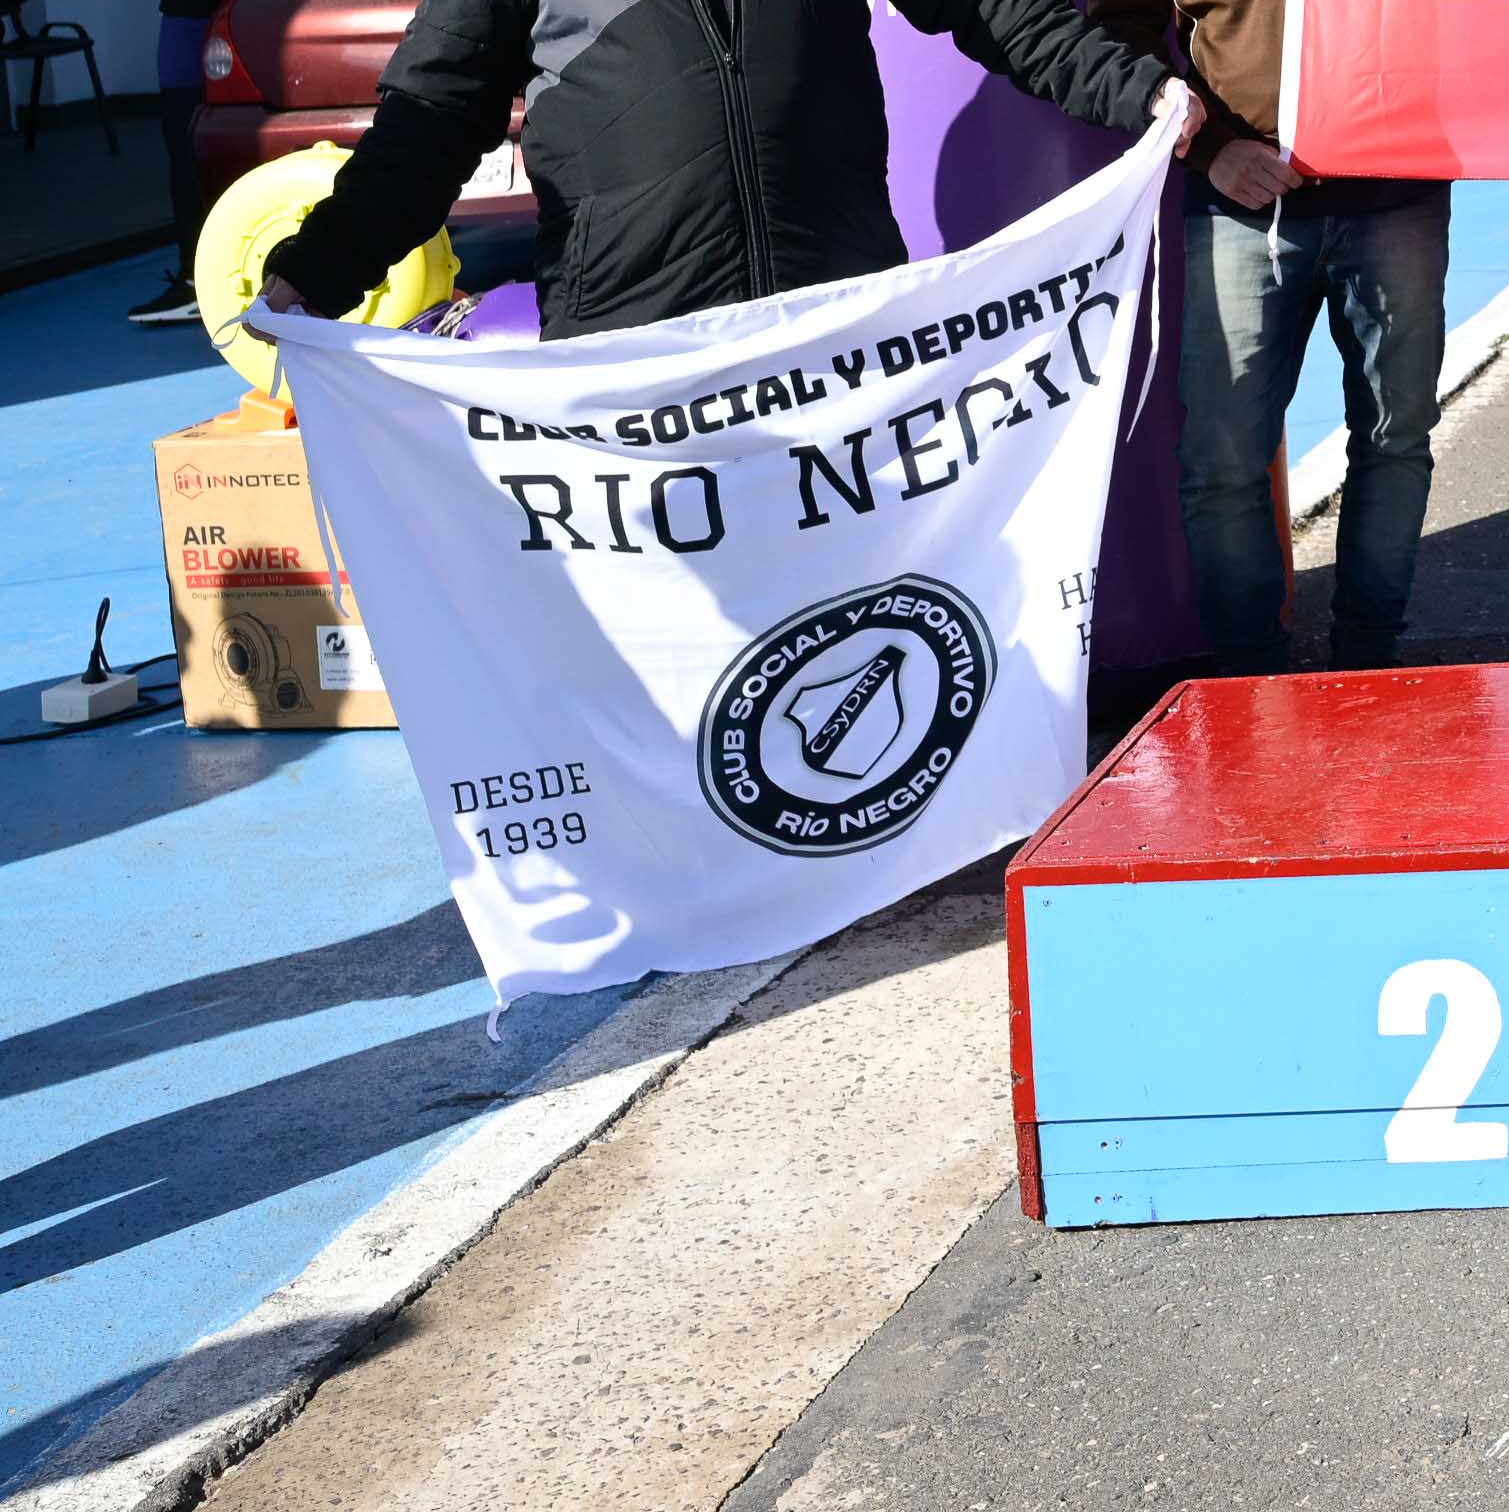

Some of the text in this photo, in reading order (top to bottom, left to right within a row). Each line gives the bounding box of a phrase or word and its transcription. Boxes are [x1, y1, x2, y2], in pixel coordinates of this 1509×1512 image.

[615, 368, 828, 447] SOCIAL
[832, 349, 866, 390] Y
[876, 231, 1125, 378] DEPORTI
[207, 474, 300, 489] INNOTEC
[500, 466, 726, 554] RIO
[182, 546, 302, 572] BLOWER
[183, 526, 227, 546] AIR
[729, 624, 837, 720] SOCIAL
[871, 594, 975, 718] DEPORTIVO
[810, 658, 889, 754] CSyDRN
[450, 762, 592, 815] DESDE
[723, 728, 760, 804] CLUB
[839, 746, 952, 834] NEGRO
[476, 811, 588, 858] 1939
[1377, 958, 1509, 1164] 2
